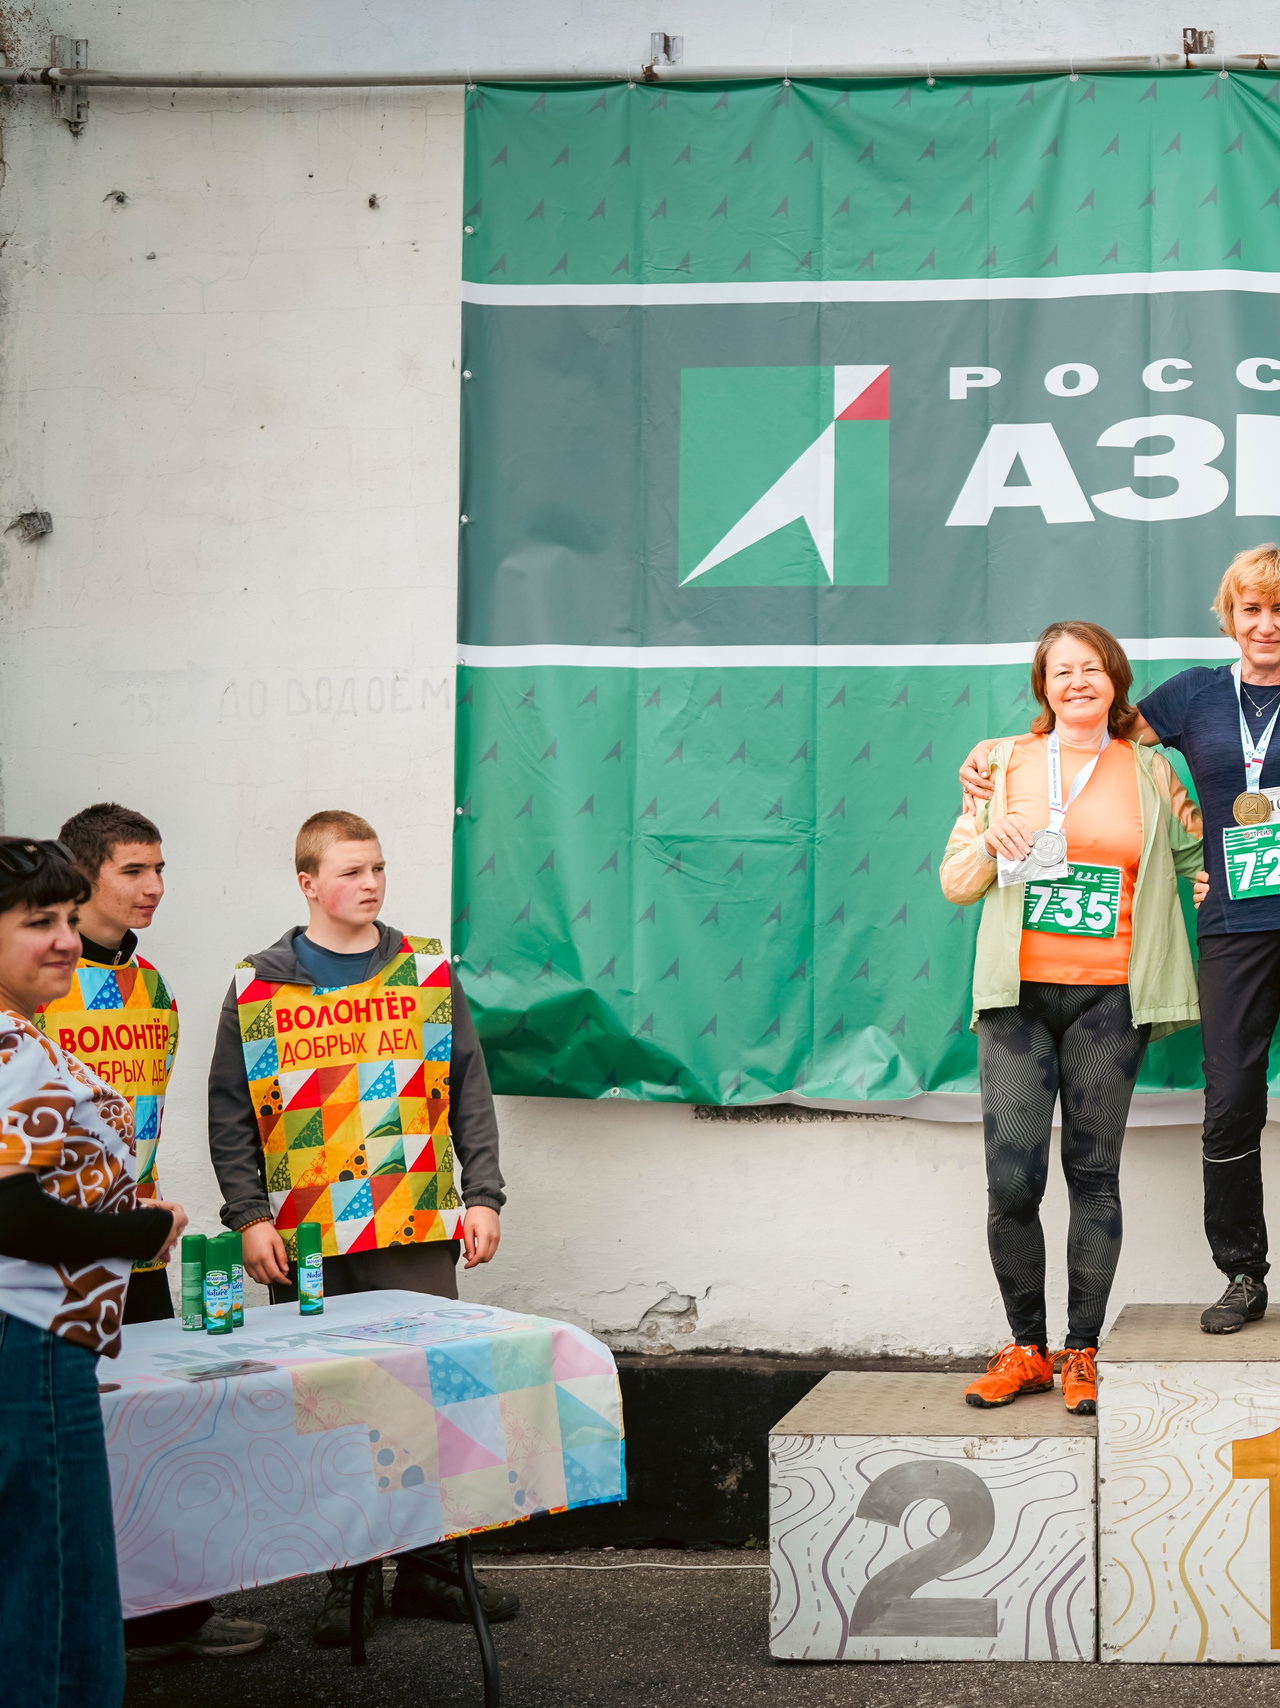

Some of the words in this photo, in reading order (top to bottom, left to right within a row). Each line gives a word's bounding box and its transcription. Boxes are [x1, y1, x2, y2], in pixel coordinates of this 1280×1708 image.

[1027, 885, 1112, 930] 735
[276, 991, 417, 1034] ВОЛОНТЁР
[58, 1018, 169, 1054] ВОЛОНТЁР
[281, 1032, 368, 1069] ДОБРЫХ
[377, 1028, 418, 1056] ДЕЛ
[84, 1060, 146, 1084] БРЫХ
[207, 1288, 228, 1297] Nature
[847, 1459, 999, 1638] 2
